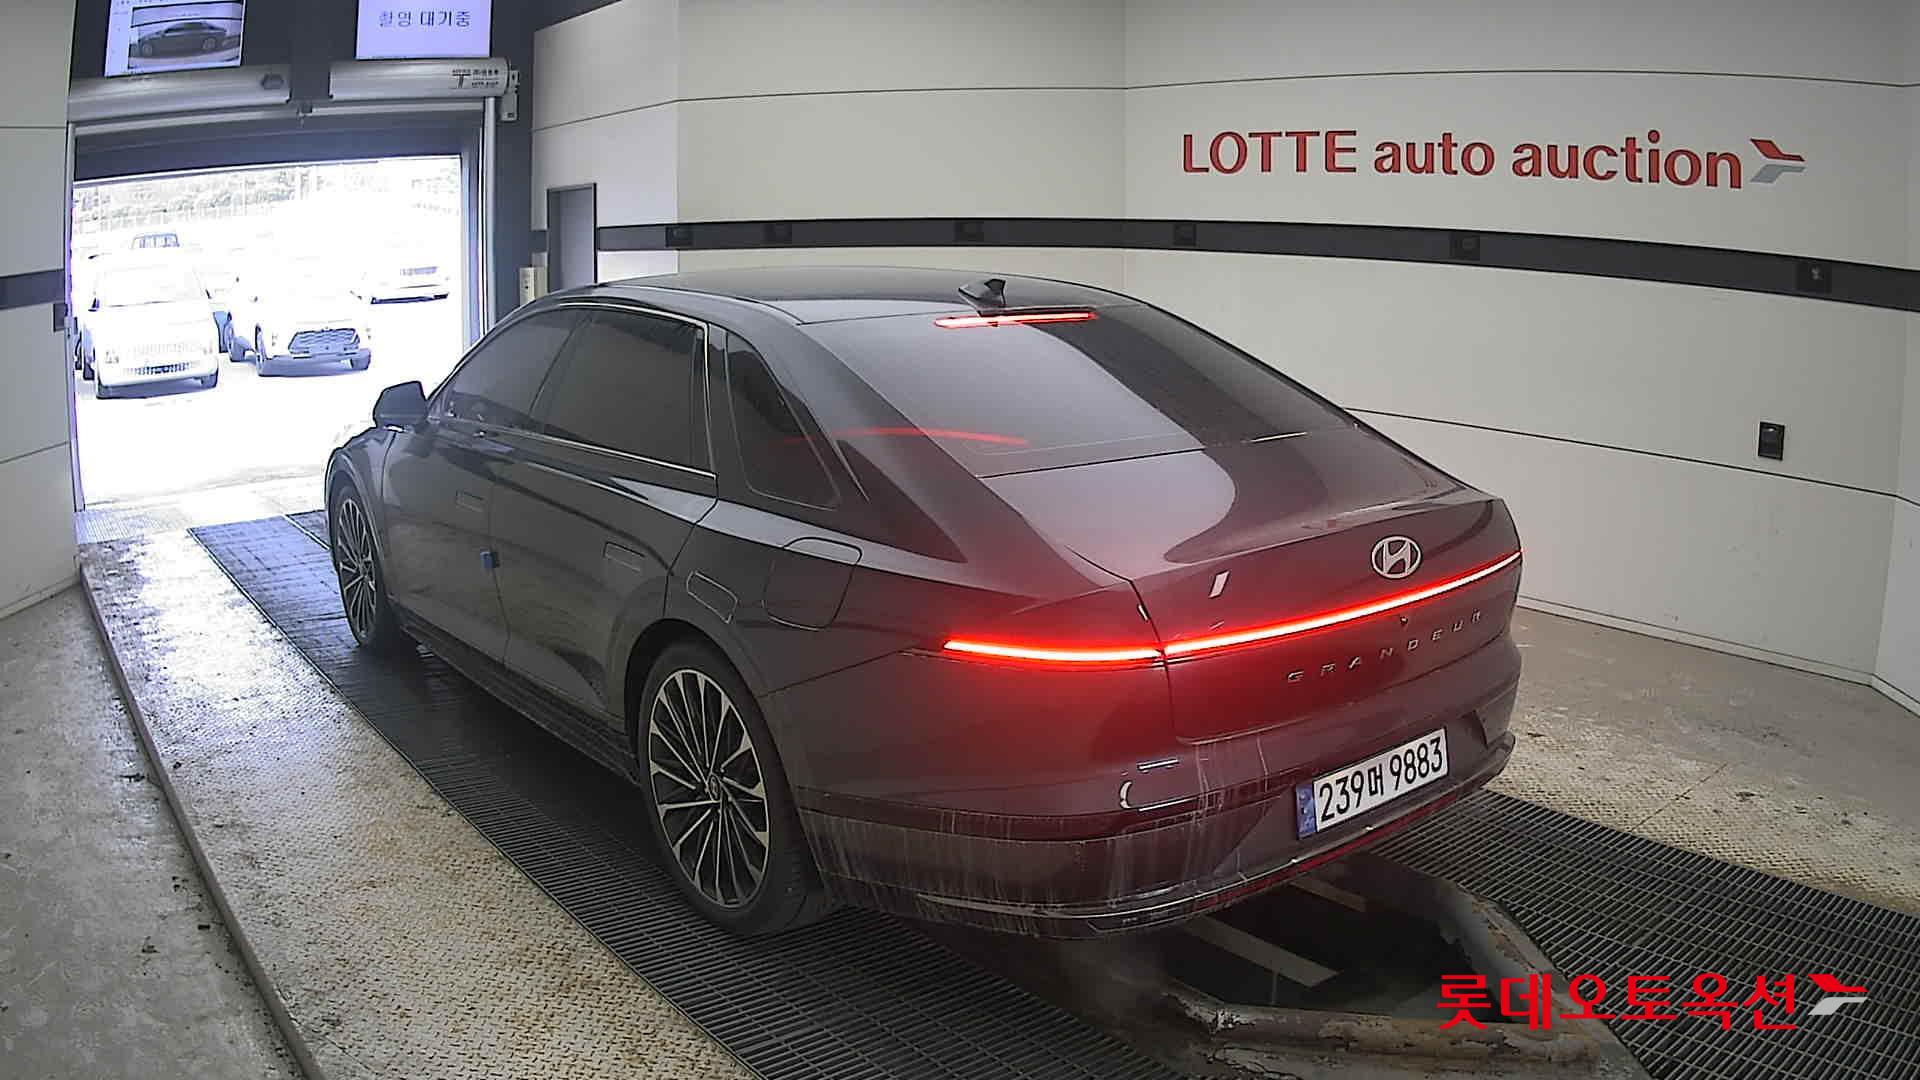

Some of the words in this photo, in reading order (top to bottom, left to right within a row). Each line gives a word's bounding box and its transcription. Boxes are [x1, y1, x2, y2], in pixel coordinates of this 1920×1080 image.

[420, 11, 471, 27] 대기중
[1183, 130, 1357, 175] LOTTE
[1374, 131, 1495, 177] auto
[1511, 130, 1742, 189] auction
[1389, 736, 1443, 791] 9883
